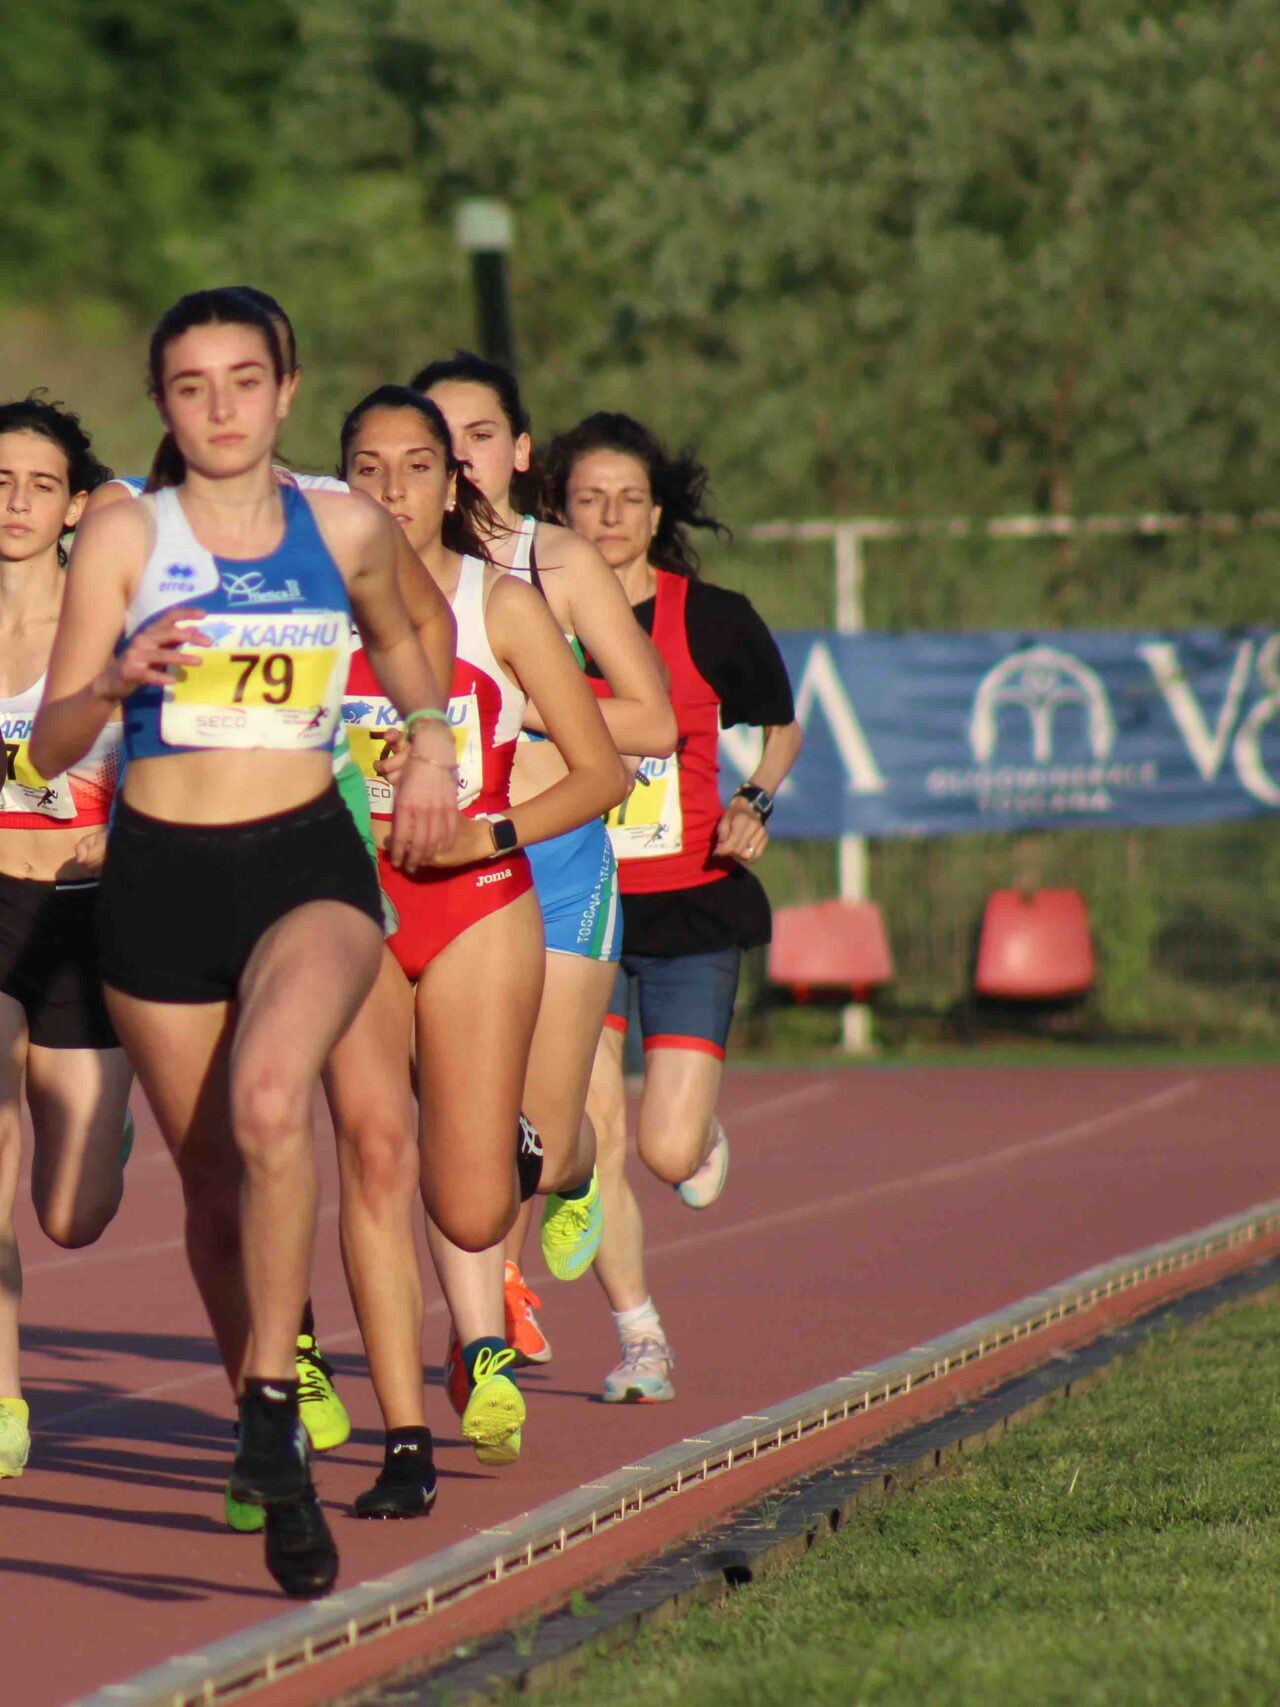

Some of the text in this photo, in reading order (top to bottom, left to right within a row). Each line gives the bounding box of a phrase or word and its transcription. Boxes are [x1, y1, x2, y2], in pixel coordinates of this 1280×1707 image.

[238, 622, 339, 648] KARHU
[230, 653, 294, 704] 79
[196, 715, 246, 728] SECO
[476, 868, 513, 887] Joma
